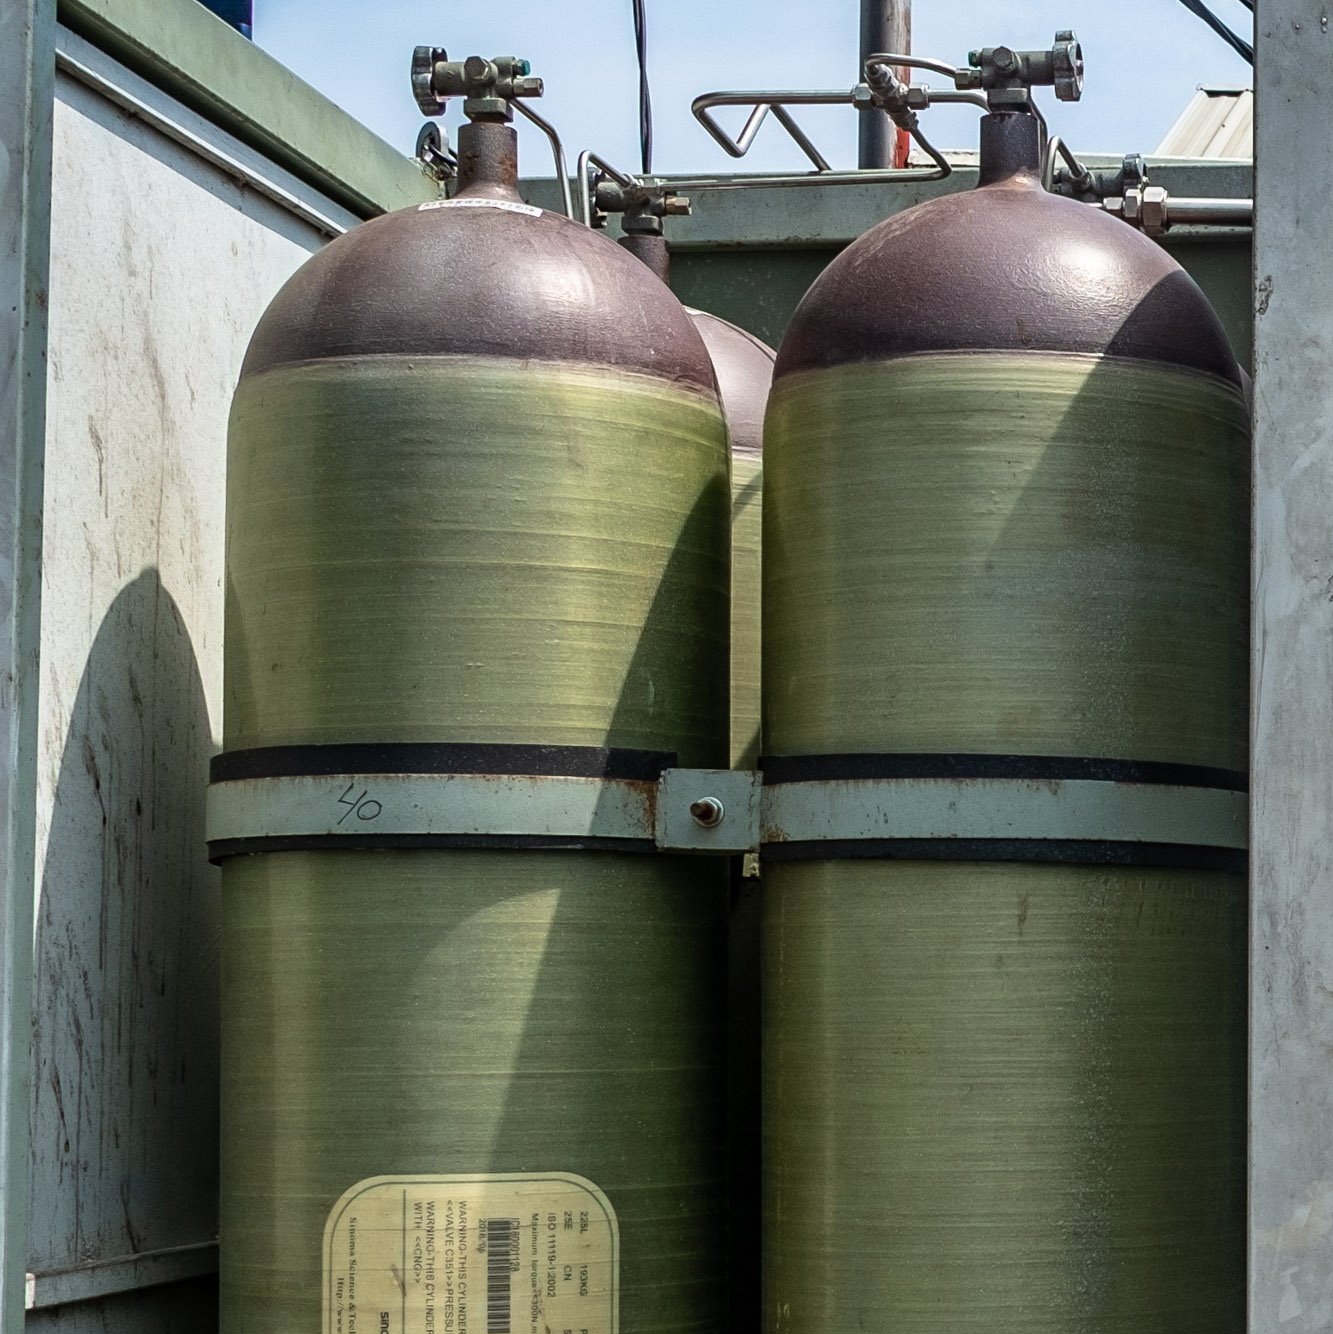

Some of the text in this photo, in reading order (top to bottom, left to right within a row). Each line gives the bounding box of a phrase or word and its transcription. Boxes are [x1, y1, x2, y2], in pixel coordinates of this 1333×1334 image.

[414, 1202, 422, 1228] WITH
[349, 1217, 357, 1256] Sinoma
[531, 1213, 539, 1255] Maximum
[564, 1265, 572, 1281] CN
